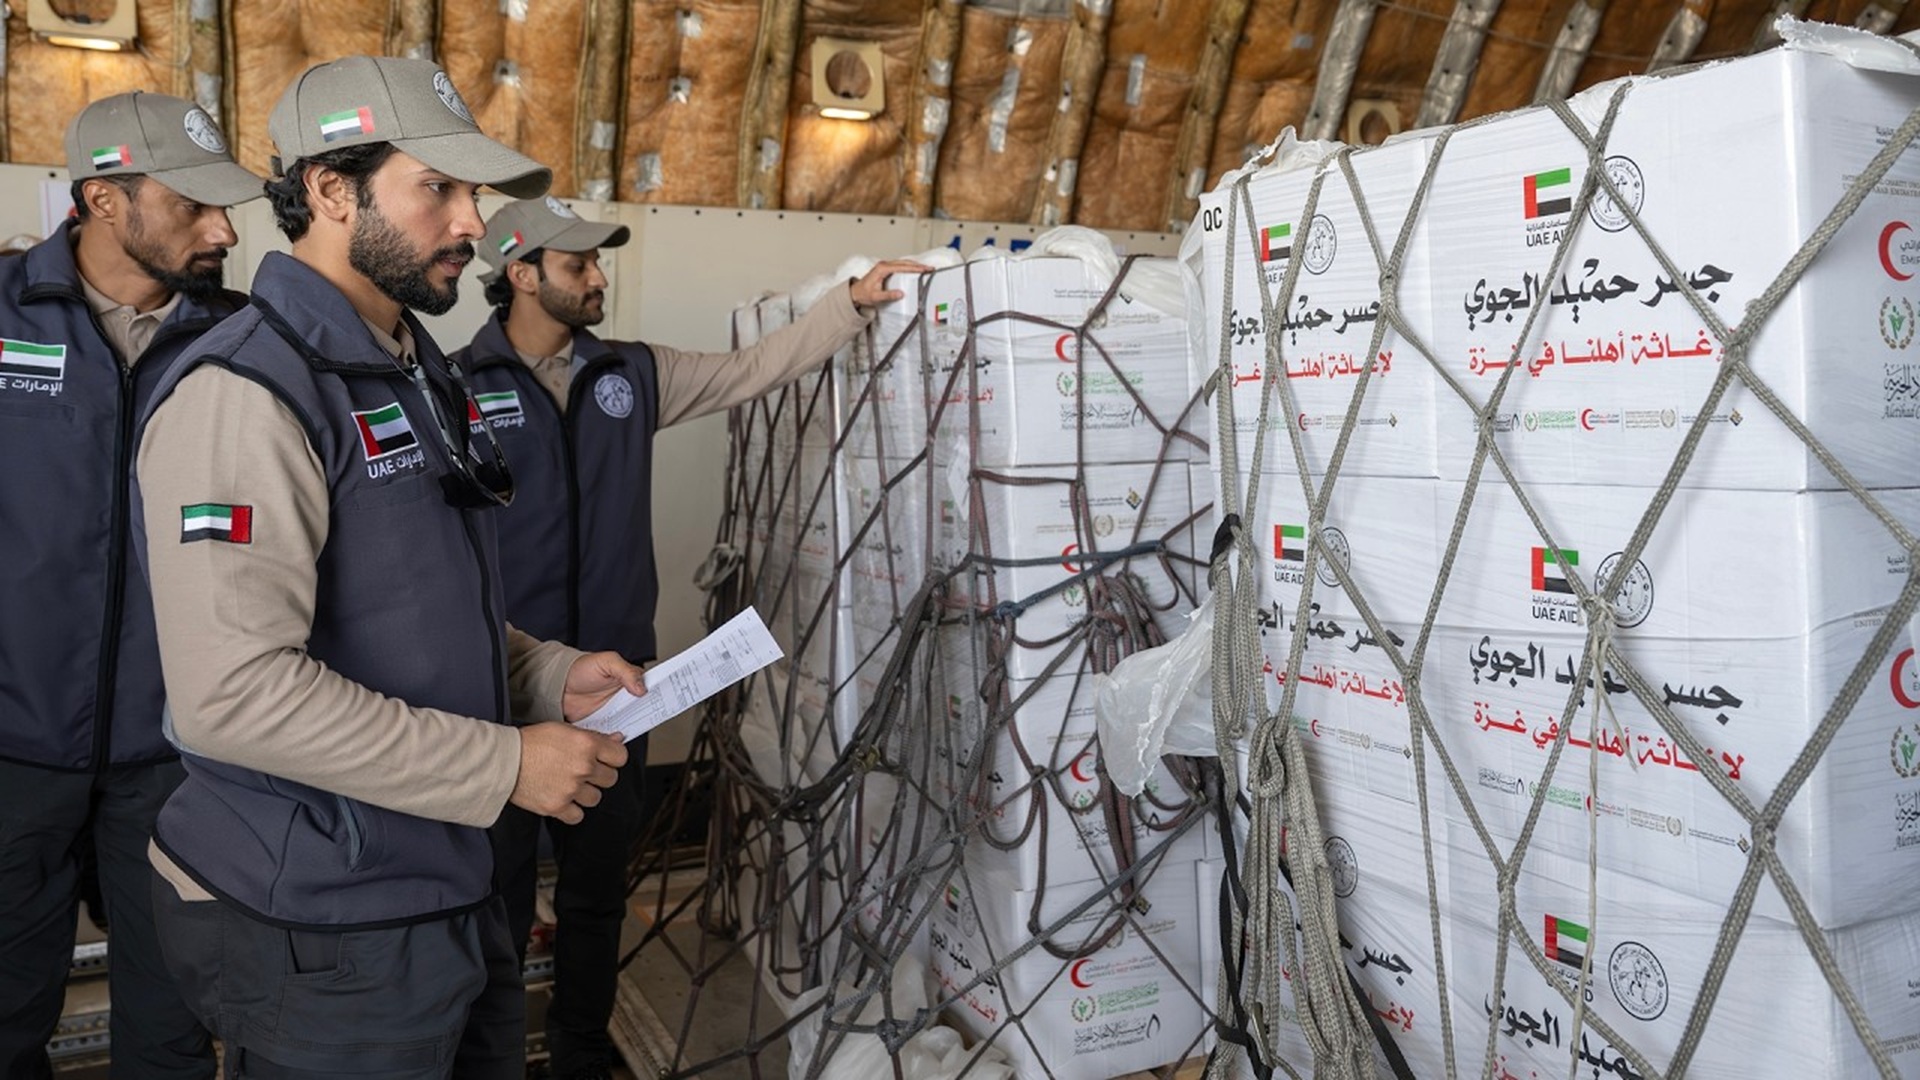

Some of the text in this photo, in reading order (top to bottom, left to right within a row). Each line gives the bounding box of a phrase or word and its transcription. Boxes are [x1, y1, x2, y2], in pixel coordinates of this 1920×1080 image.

[1203, 206, 1223, 232] QC
[1526, 229, 1566, 248] UAE AI
[1464, 271, 1540, 332] الجوي
[1528, 341, 1555, 378] في
[1560, 330, 1625, 365] أهلنا
[1631, 328, 1736, 366] غاثة
[1232, 362, 1262, 388] غز
[1285, 352, 1325, 379] أهلنا
[12, 379, 63, 397] الإمارات
[470, 423, 486, 435] UA
[367, 459, 396, 479] UAE
[396, 449, 426, 469] الإمارات
[1274, 570, 1291, 584] UAE
[1257, 599, 1284, 637] الج
[1532, 605, 1578, 624] UAE AID
[1469, 635, 1546, 689] الجوي
[1297, 663, 1338, 689] أهلن
[1473, 700, 1745, 781] لإاثة أهلنا في غزة
[1353, 945, 1414, 988] جسر
[1570, 1031, 1643, 1080] ميد
